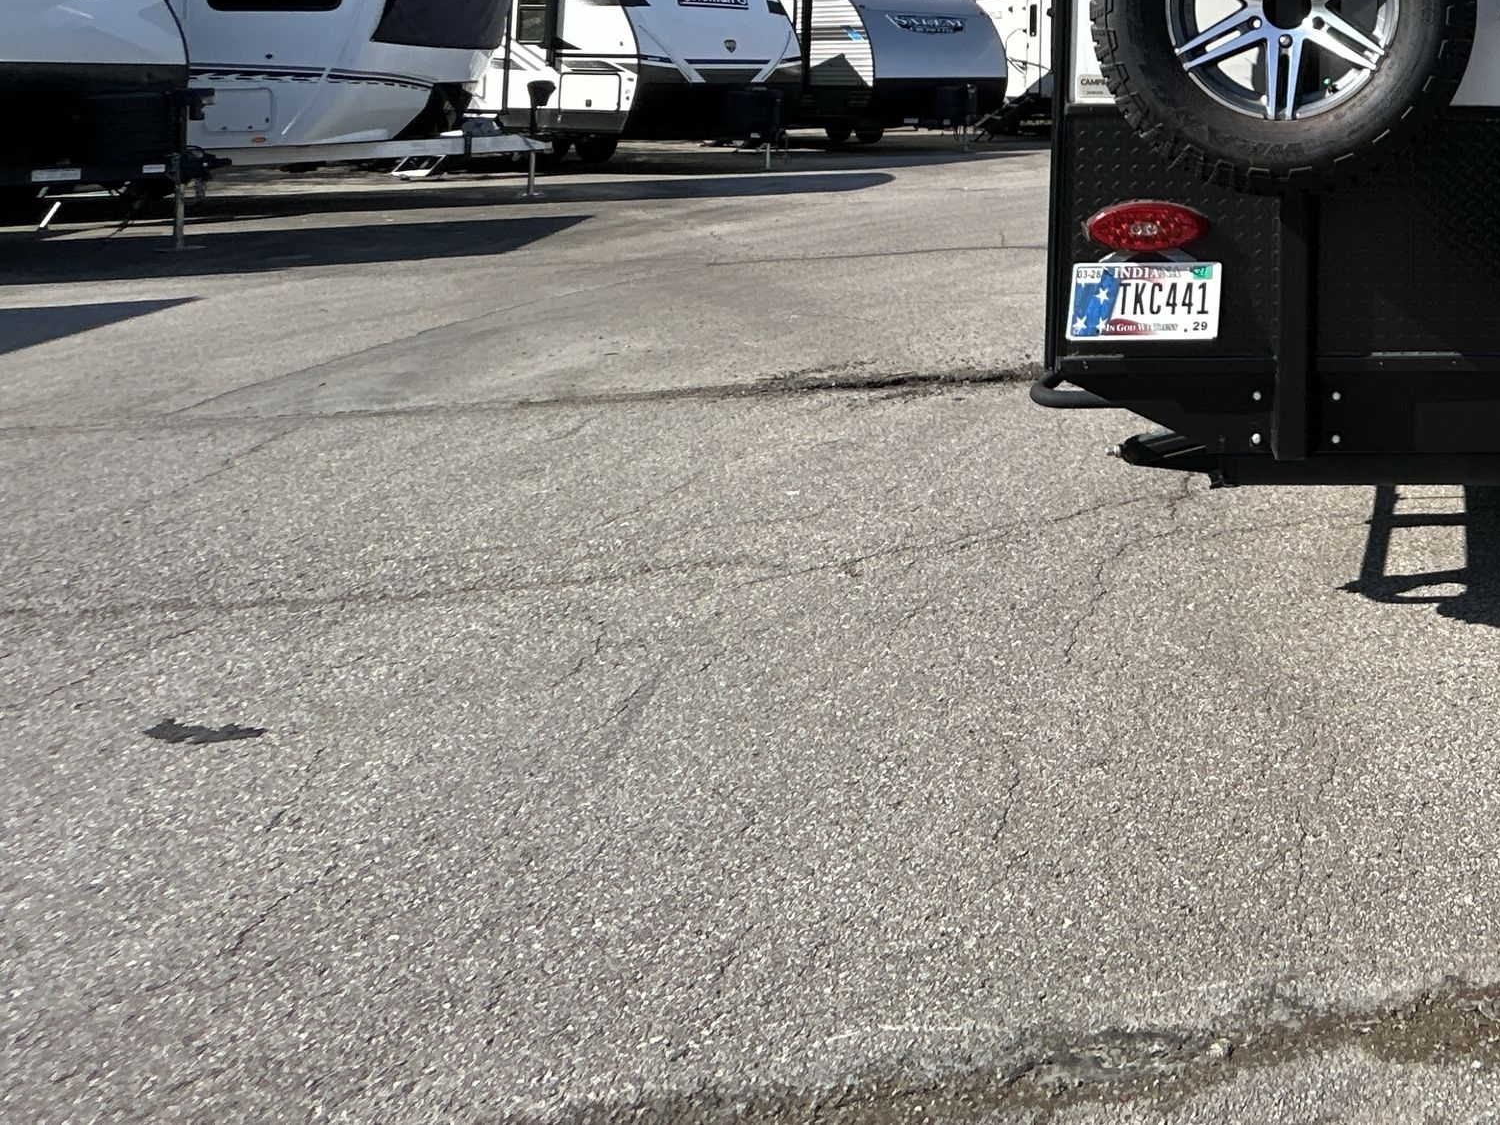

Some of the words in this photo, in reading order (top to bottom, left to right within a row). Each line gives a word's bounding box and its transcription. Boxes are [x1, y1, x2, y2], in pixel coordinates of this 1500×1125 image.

[1113, 266, 1182, 279] INDIANA
[1119, 282, 1209, 315] TKC441
[1116, 323, 1136, 332] GOD
[1192, 321, 1208, 331] 29
